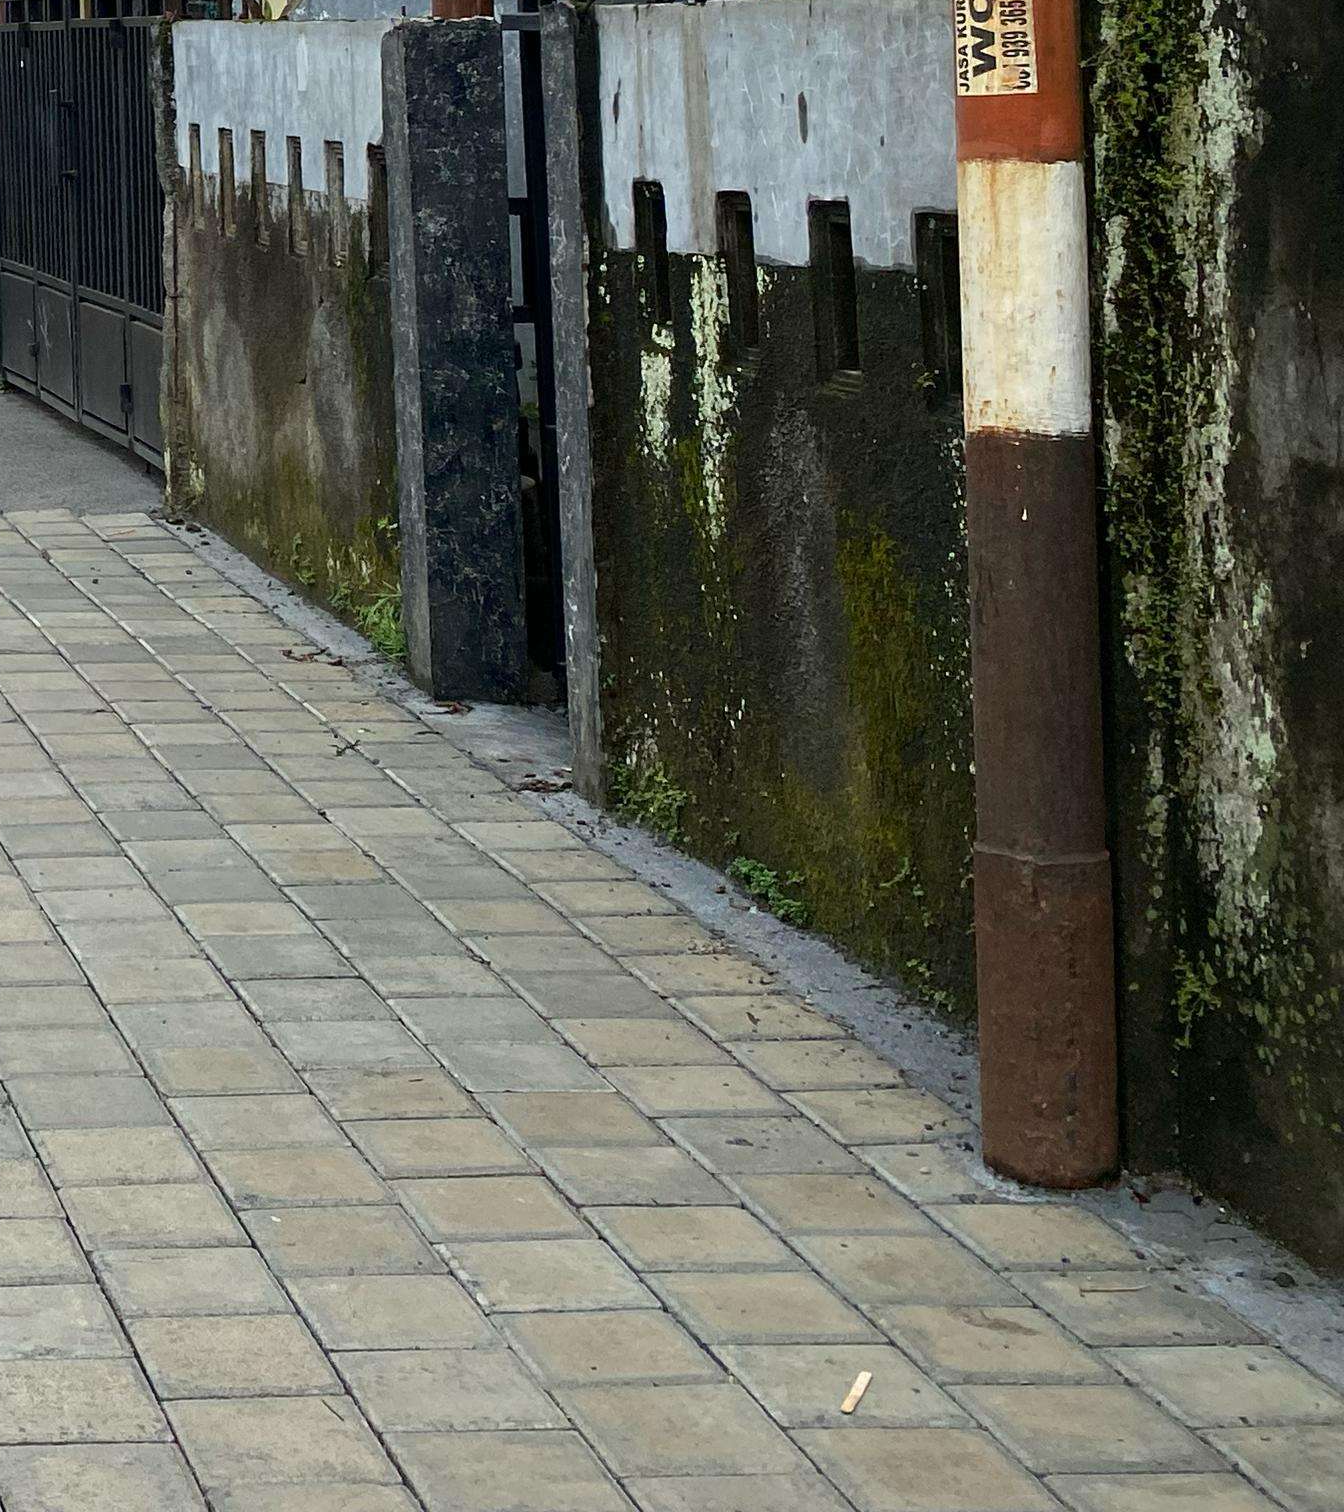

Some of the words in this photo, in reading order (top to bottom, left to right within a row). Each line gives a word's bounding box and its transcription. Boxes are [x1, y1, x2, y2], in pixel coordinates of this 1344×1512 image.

[999, 0, 1028, 27] 365
[1001, 30, 1030, 61] 939
[957, 44, 969, 92] JASA
